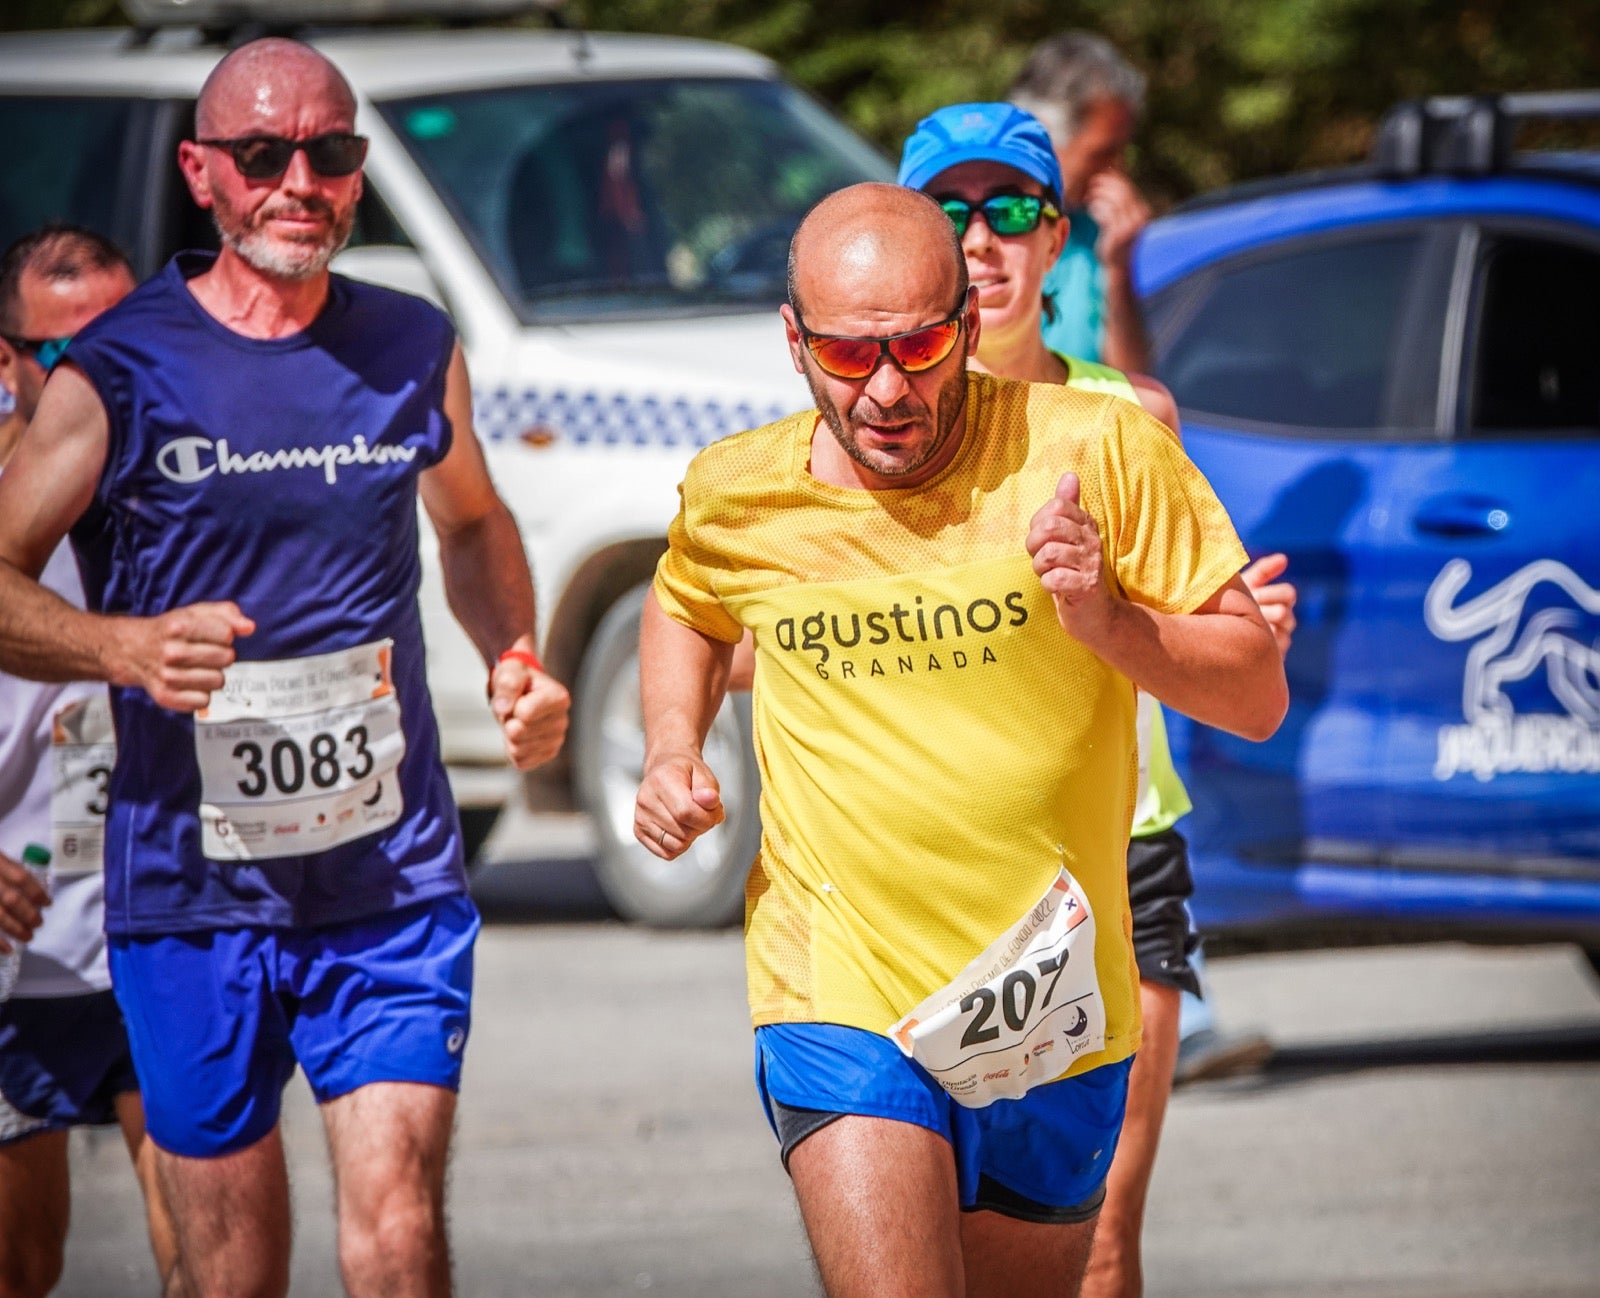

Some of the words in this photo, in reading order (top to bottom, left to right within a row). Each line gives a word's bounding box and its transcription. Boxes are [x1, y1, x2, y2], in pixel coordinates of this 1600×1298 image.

[155, 434, 417, 484] Champion
[775, 591, 1029, 664] agustinos
[816, 646, 997, 681] GRANADA
[232, 725, 374, 797] 3083
[1000, 952, 1012, 968] DE
[1008, 924, 1033, 956] FONDO
[1028, 897, 1055, 928] 2022
[960, 948, 1070, 1050] 207
